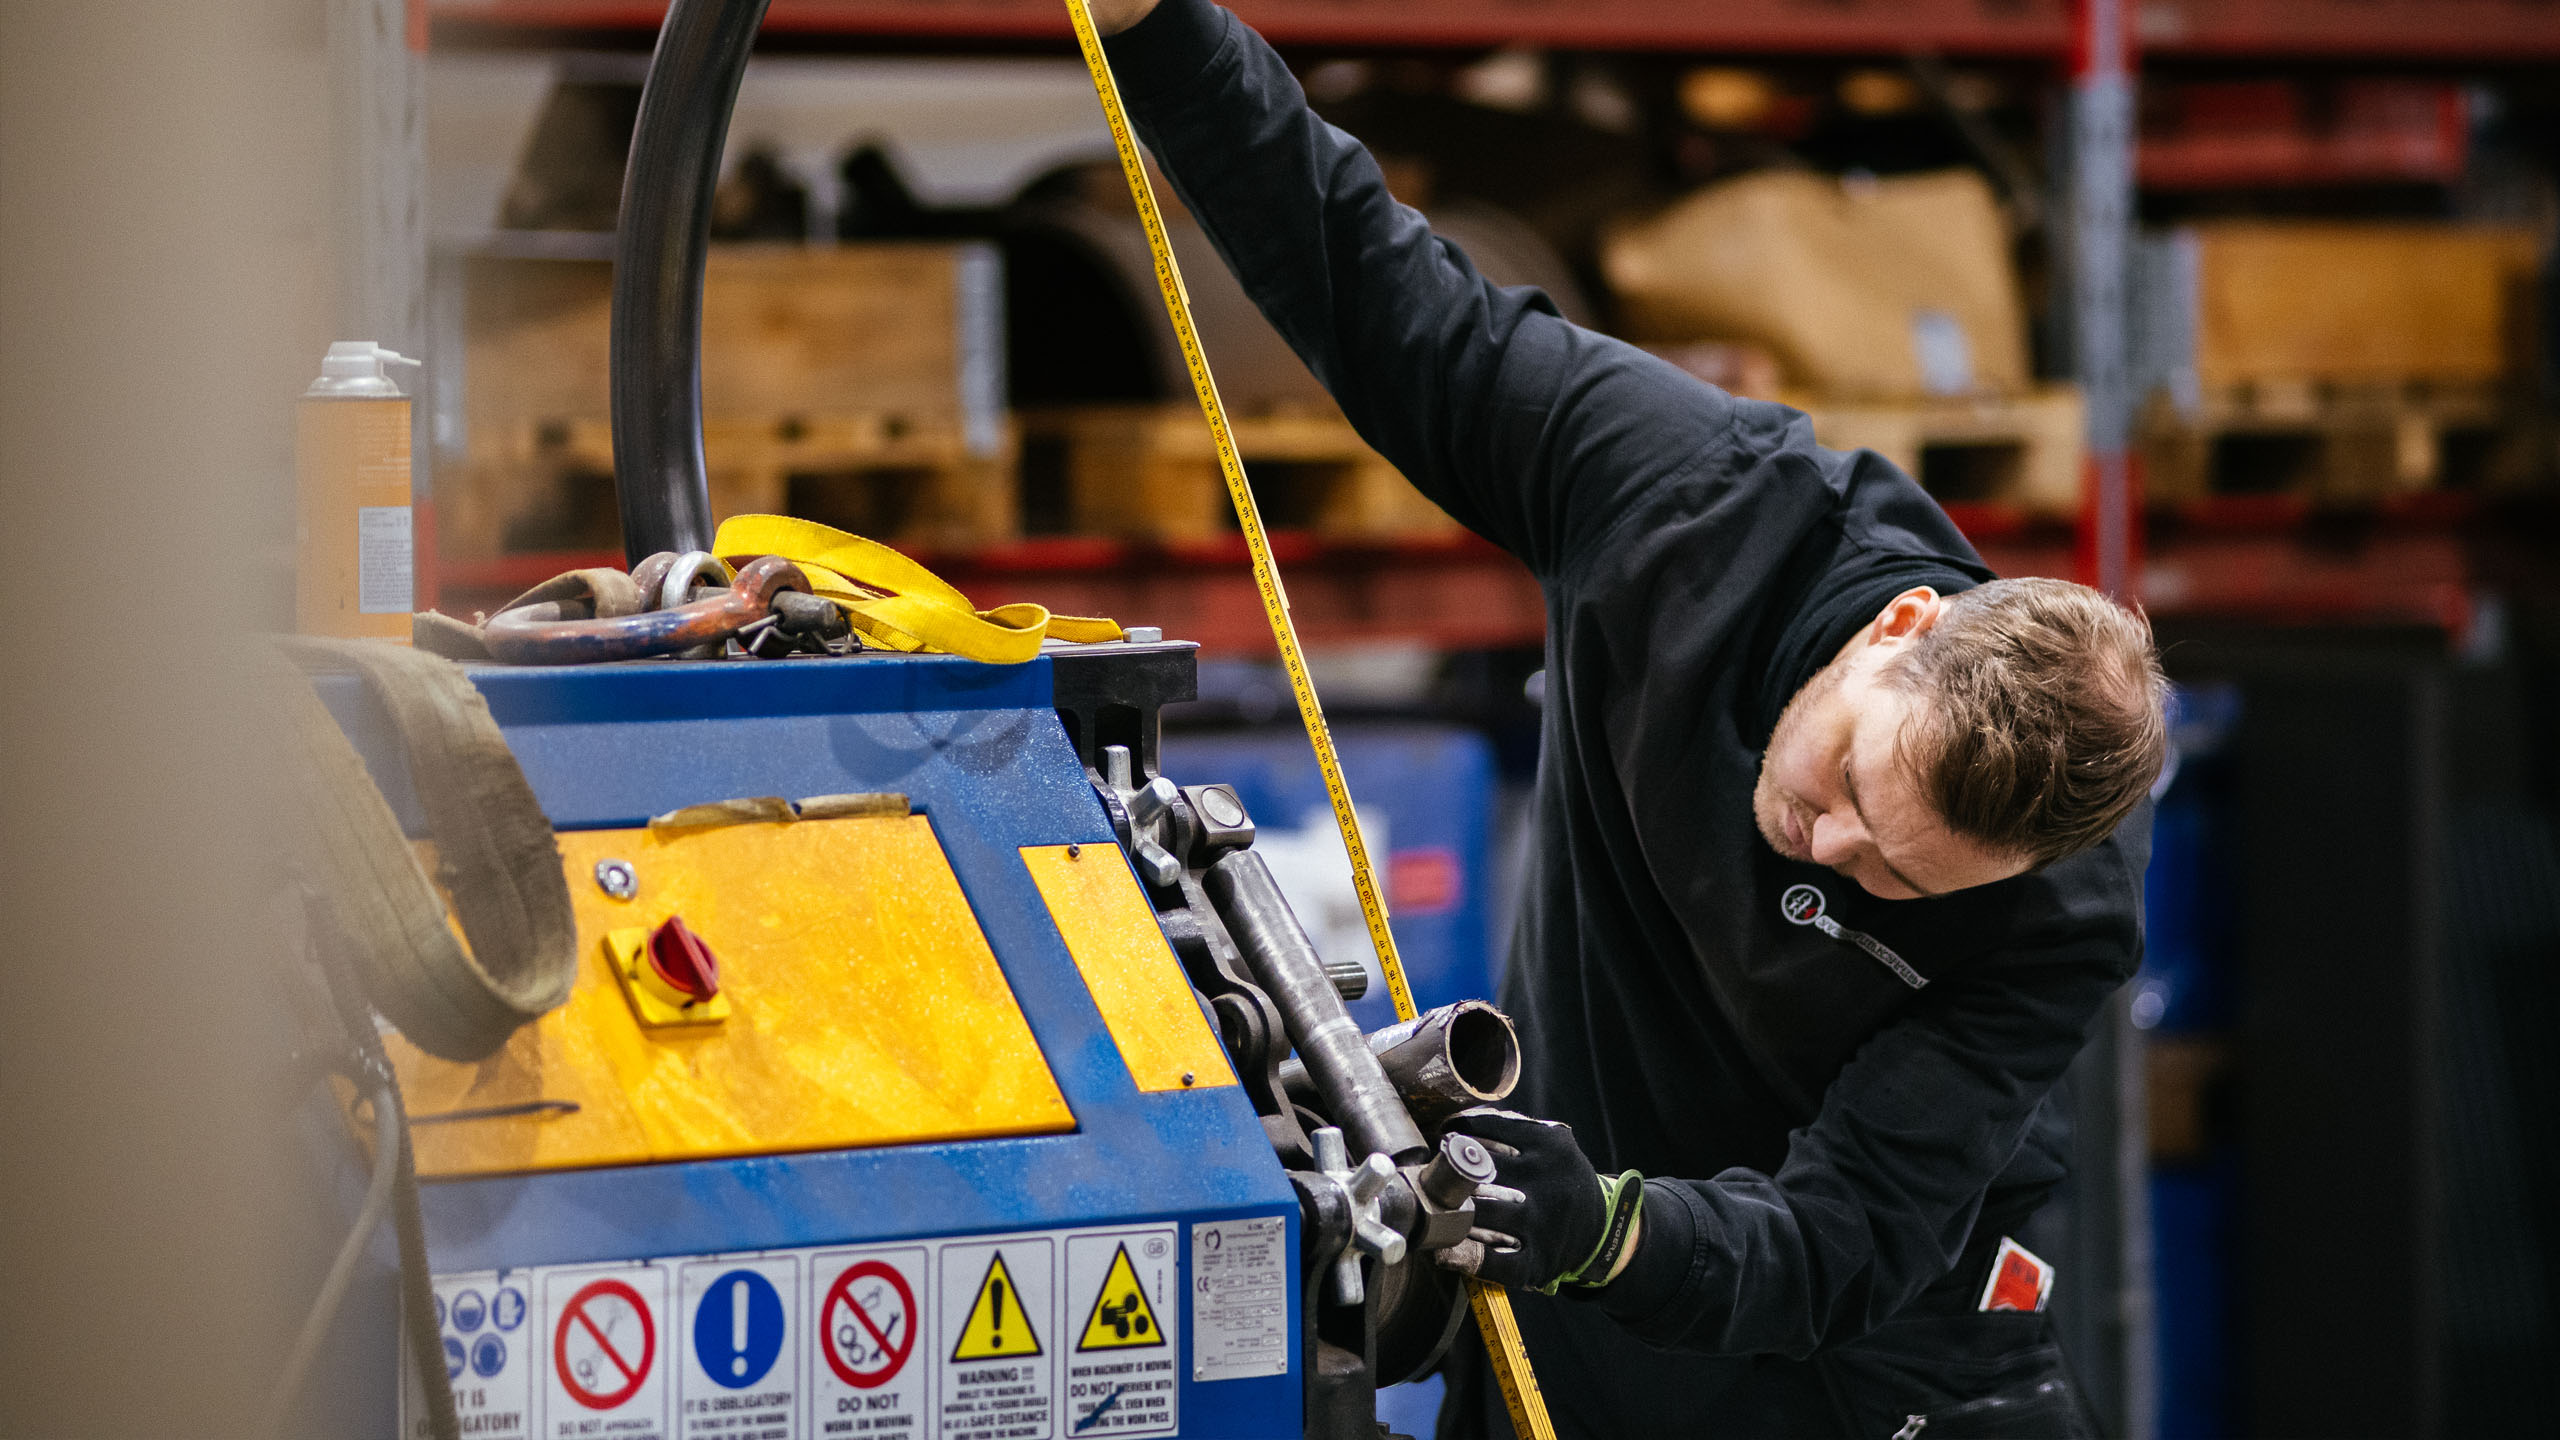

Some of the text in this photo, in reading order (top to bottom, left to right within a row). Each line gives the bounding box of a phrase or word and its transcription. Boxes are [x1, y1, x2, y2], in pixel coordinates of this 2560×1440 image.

[1115, 126, 1124, 141] 170
[1163, 277, 1173, 292] 160
[1216, 429, 1225, 443] 150
[1263, 582, 1272, 597] 140
[1315, 736, 1324, 750] 130
[1362, 890, 1372, 906] 120
[958, 1367, 1018, 1385] WARNING
[1071, 1360, 1172, 1377] WHEN MACHINERY IS MOVING
[1070, 1383, 1087, 1398] DO
[1090, 1381, 1114, 1395] NOT
[1155, 1379, 1172, 1391] WITH
[837, 1393, 900, 1413] DO NOT
[1125, 1398, 1143, 1410] EVEN
[1145, 1397, 1165, 1408] WHEN
[970, 1413, 995, 1427] SAFE
[998, 1409, 1047, 1425] DISTANCE
[1112, 1415, 1125, 1426] THE
[1127, 1413, 1147, 1425] WORK
[1149, 1411, 1169, 1423] PIECE
